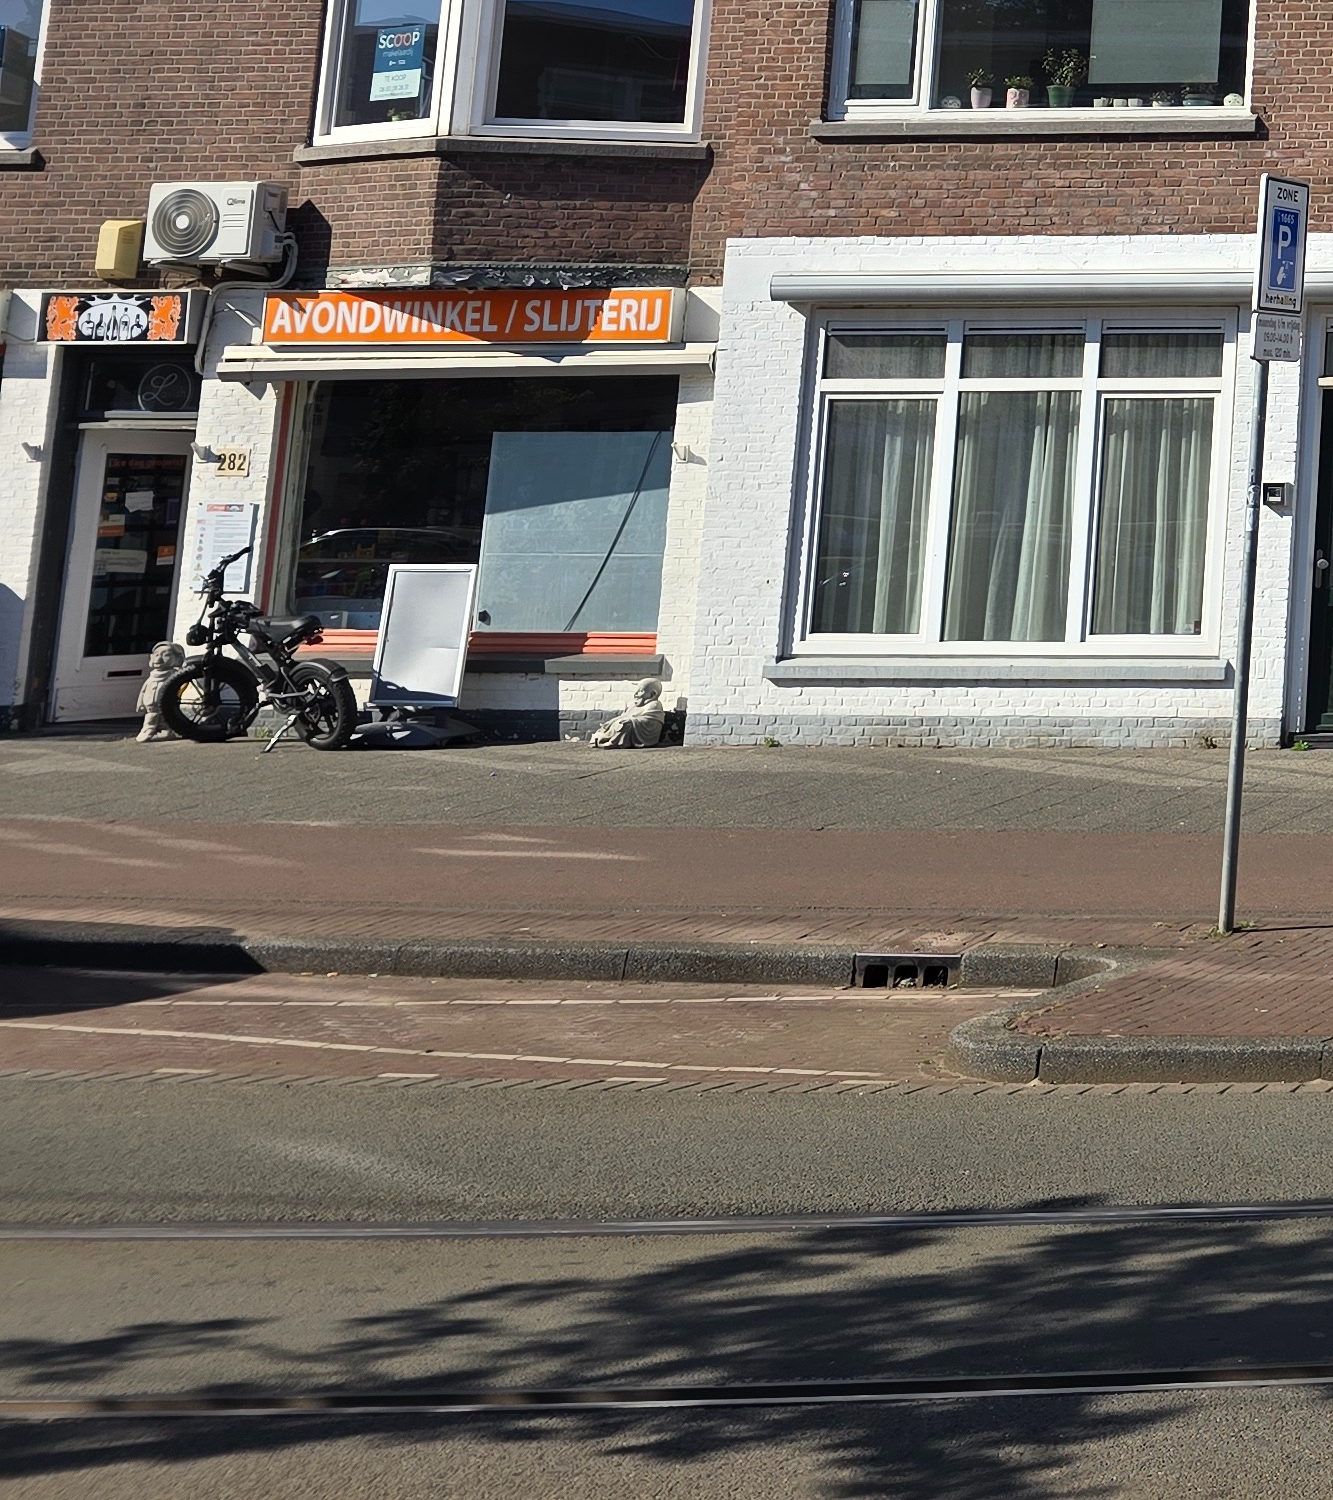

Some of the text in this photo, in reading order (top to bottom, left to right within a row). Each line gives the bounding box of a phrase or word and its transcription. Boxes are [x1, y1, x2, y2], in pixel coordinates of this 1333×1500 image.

[378, 31, 420, 49] SCOOP
[1277, 187, 1299, 202] ZONE
[1277, 224, 1292, 260] P
[1265, 293, 1297, 309] herhaling
[271, 298, 664, 335] AVONDWINKEL / SLIJTERIJ
[216, 452, 247, 471] 282
